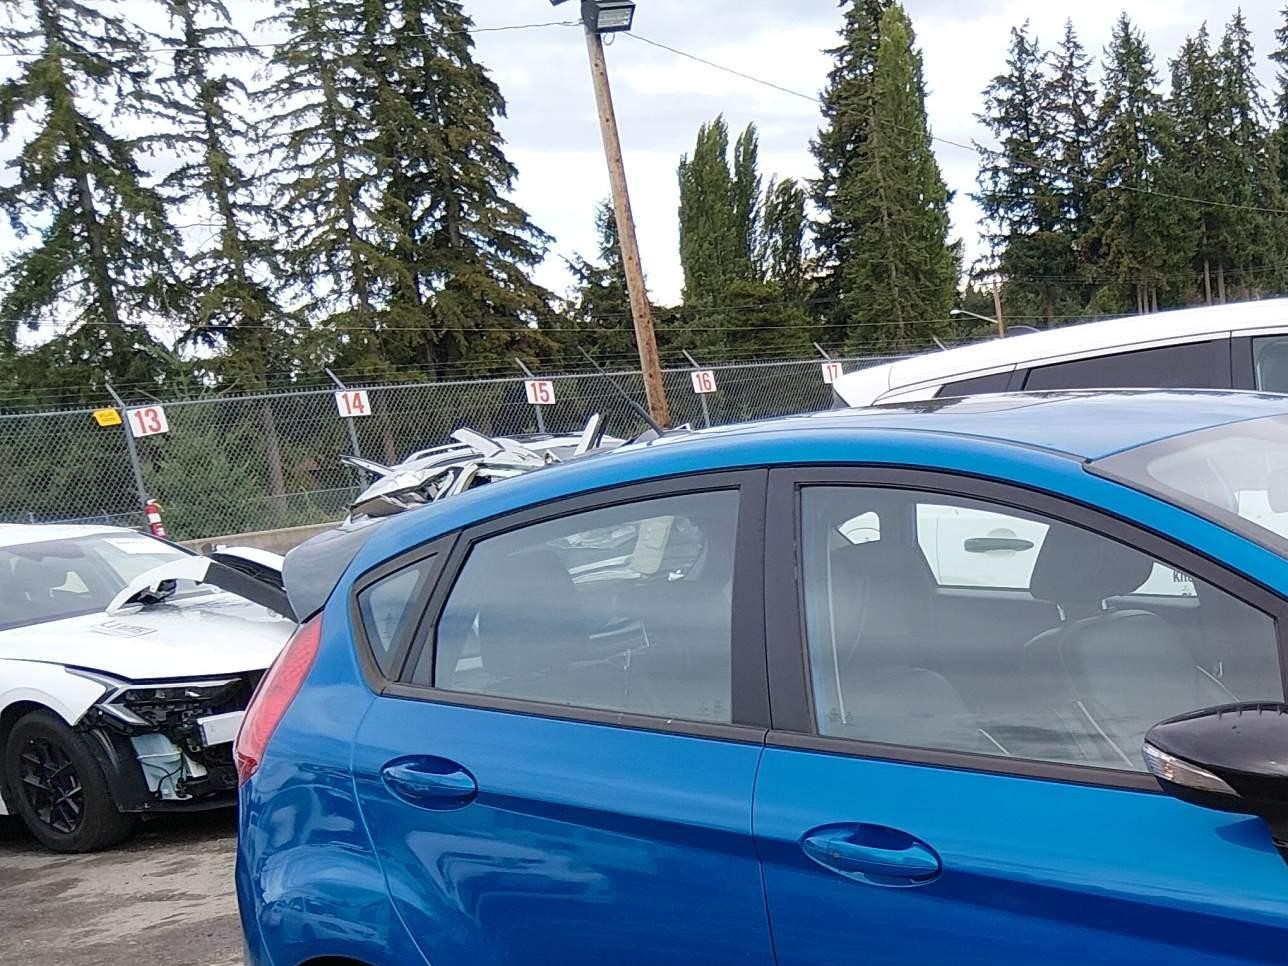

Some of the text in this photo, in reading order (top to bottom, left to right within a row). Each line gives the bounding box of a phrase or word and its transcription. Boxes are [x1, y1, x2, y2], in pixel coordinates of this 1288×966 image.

[531, 382, 549, 402] 15
[696, 373, 711, 391] 16
[342, 393, 364, 414] 14
[135, 408, 162, 434] 13
